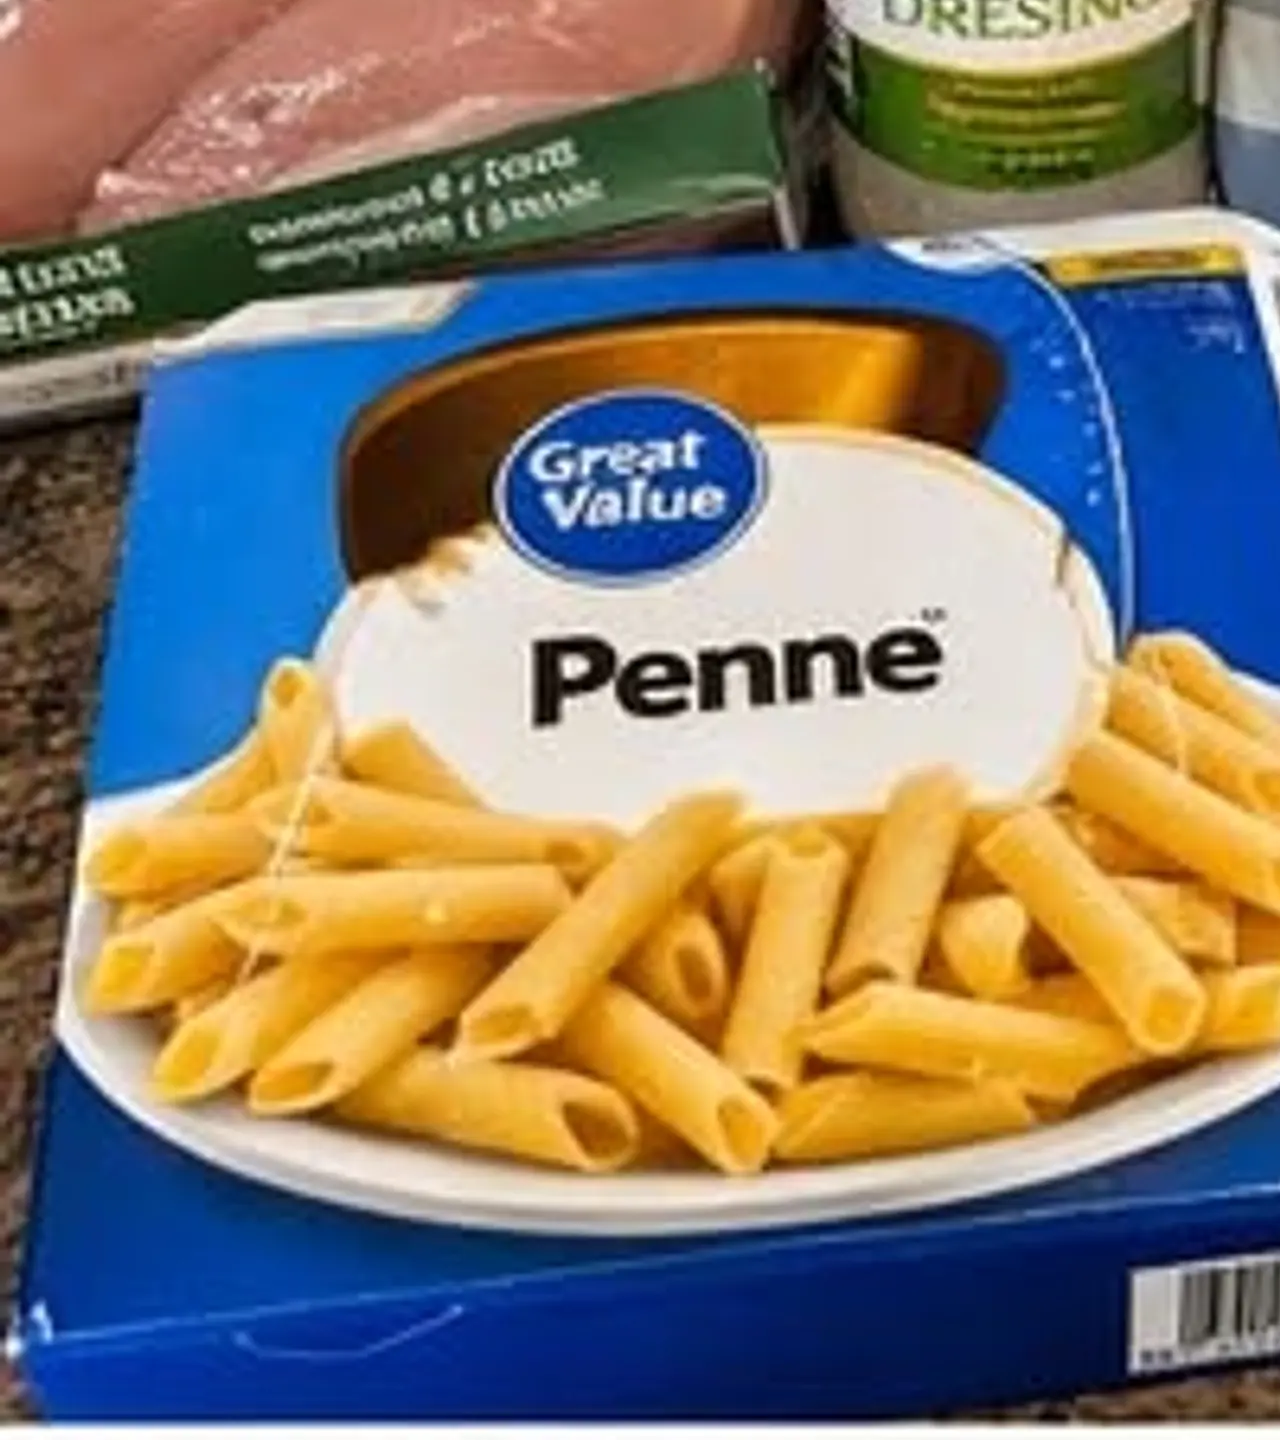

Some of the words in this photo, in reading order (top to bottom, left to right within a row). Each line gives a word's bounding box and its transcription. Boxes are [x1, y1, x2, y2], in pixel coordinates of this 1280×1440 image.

[529, 429, 706, 483] Great
[542, 481, 728, 531] Value
[531, 626, 943, 729] Penne
